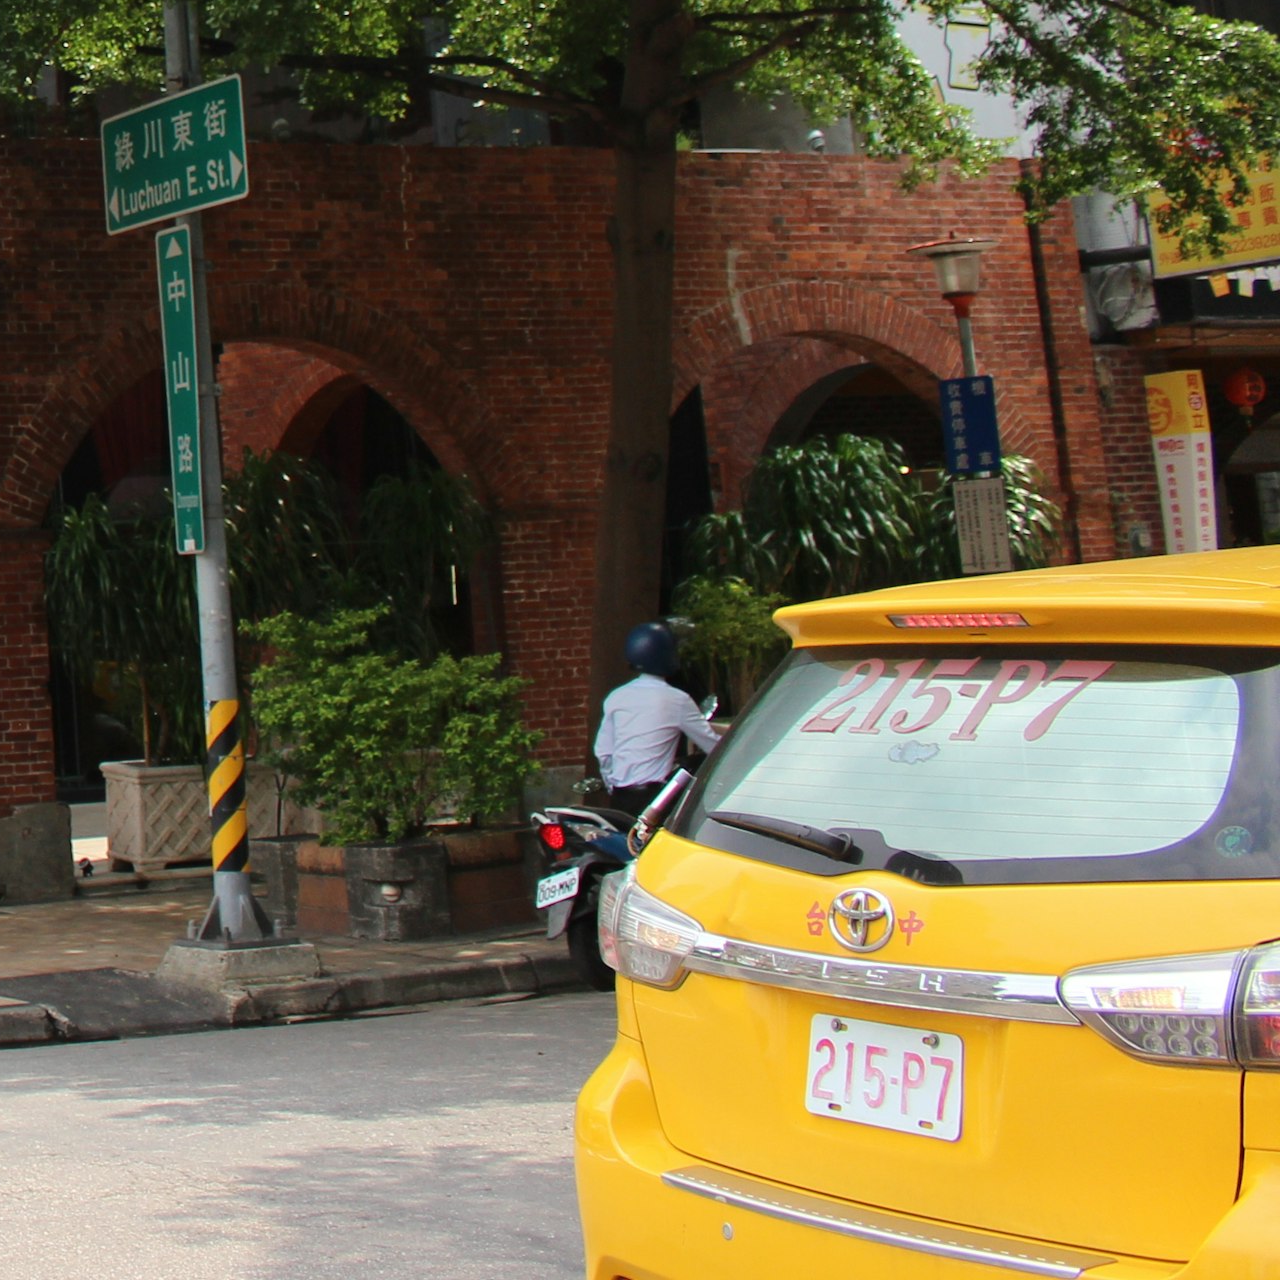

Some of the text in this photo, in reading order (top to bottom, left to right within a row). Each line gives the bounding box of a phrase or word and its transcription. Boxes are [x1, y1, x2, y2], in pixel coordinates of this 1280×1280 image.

[113, 99, 228, 173] 綠川東街
[121, 159, 231, 217] Luchuan E. St.
[167, 270, 194, 475] 中山路
[800, 656, 1117, 742] 215-P7
[806, 901, 925, 947] 台 中
[811, 1037, 955, 1122] 215-P7
